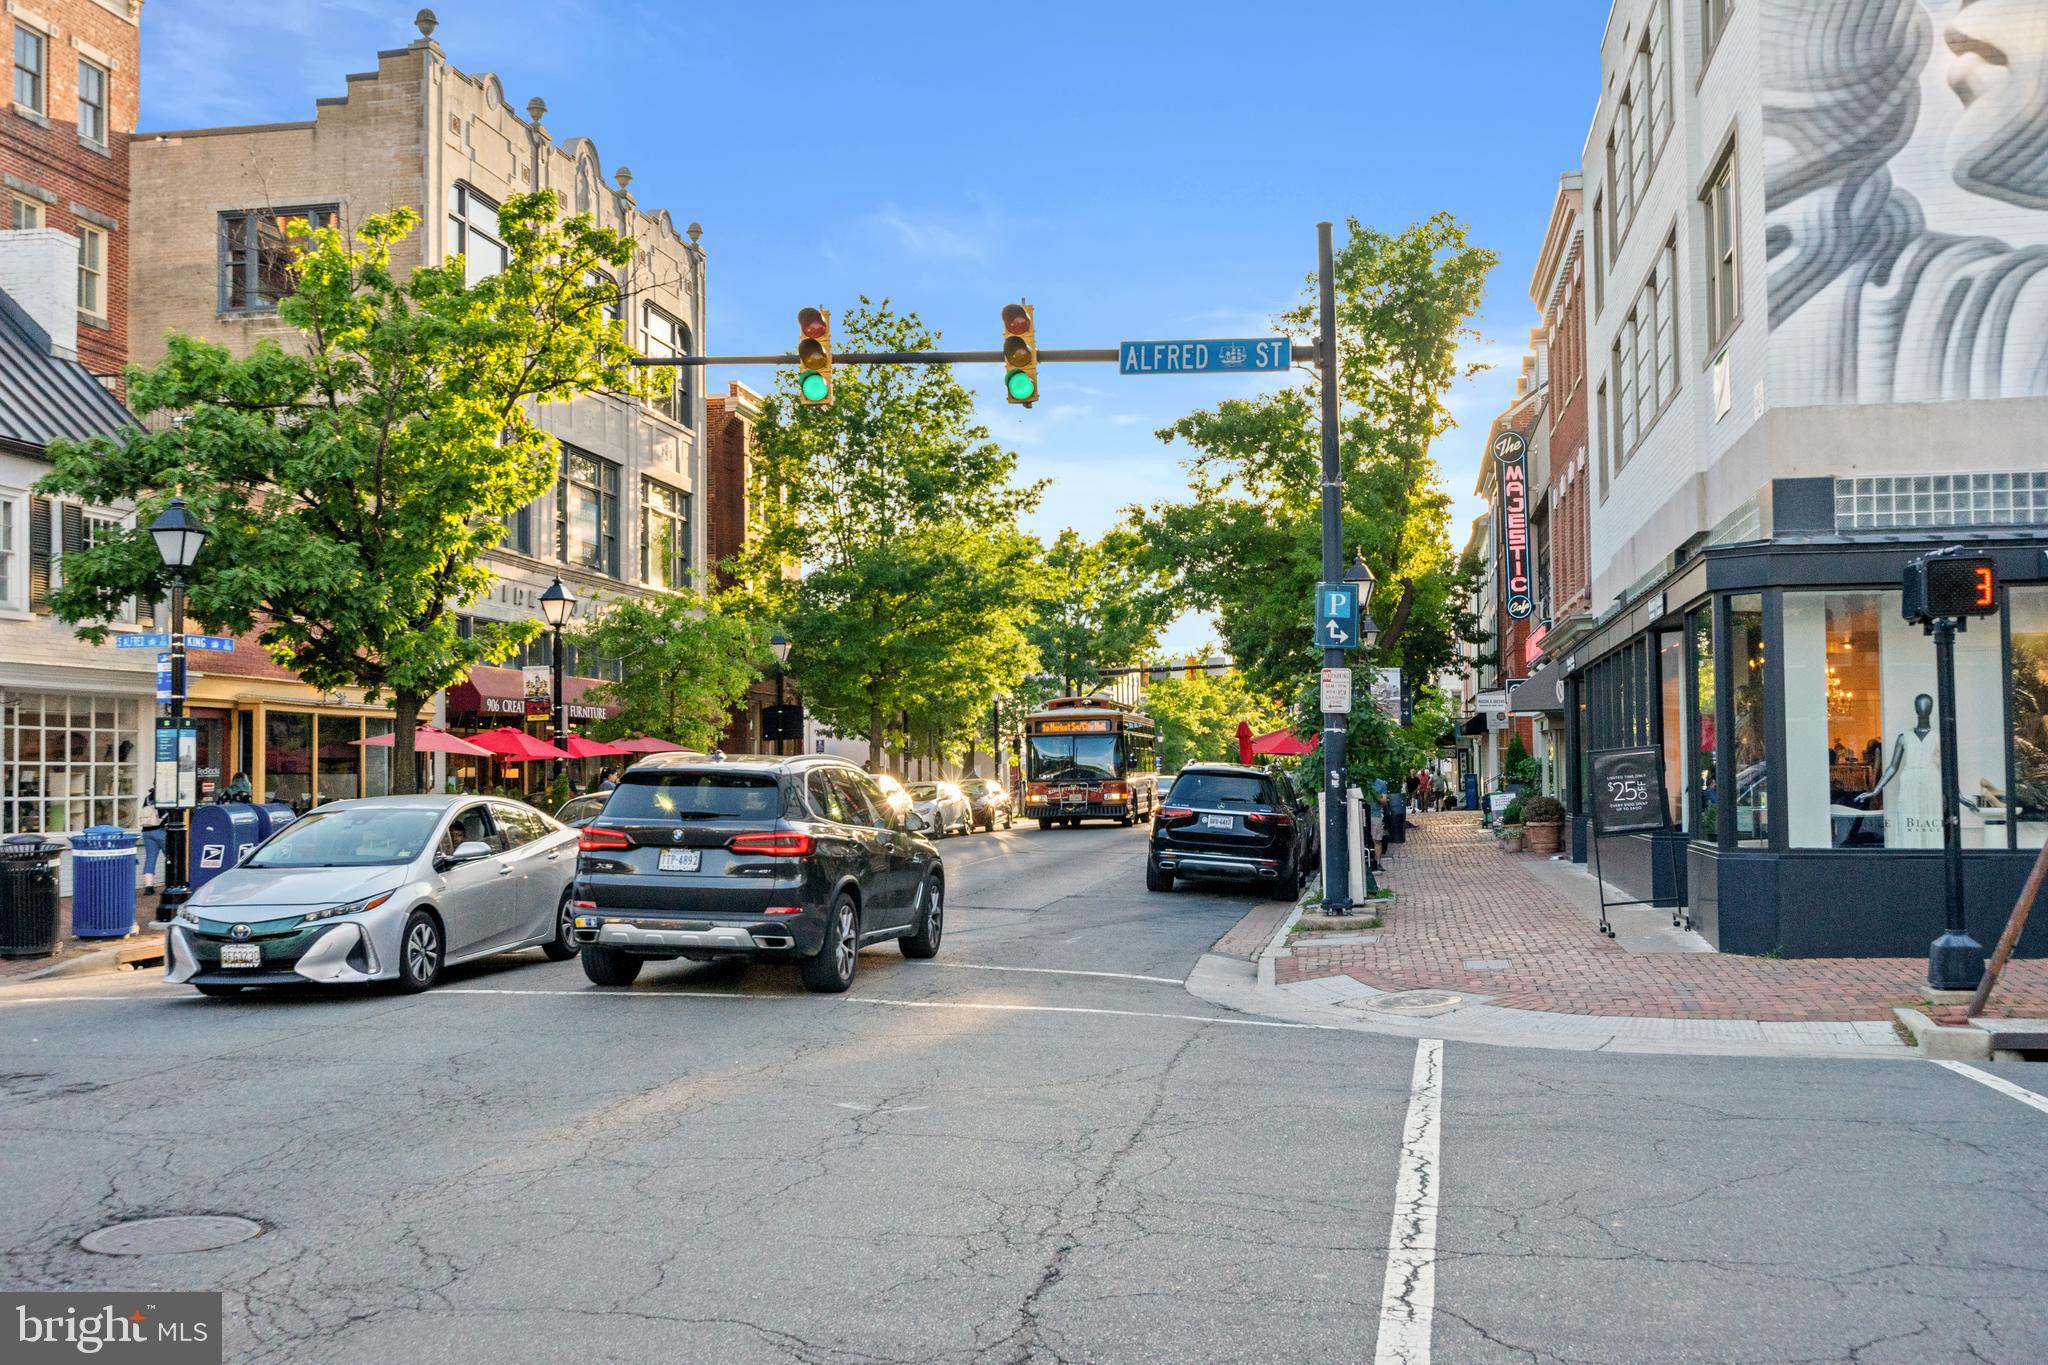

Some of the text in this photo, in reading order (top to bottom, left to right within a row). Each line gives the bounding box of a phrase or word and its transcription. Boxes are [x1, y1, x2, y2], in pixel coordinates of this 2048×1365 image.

[1125, 341, 1282, 370] ALFRED ST
[1496, 437, 1522, 457] The
[1505, 465, 1528, 593] MAJESTIC
[1975, 567, 1993, 606] 3
[1328, 593, 1346, 615] P
[187, 636, 206, 648] KING
[486, 698, 500, 712] 906
[570, 705, 607, 719] FURNITURE
[1607, 781, 1637, 801] $25
